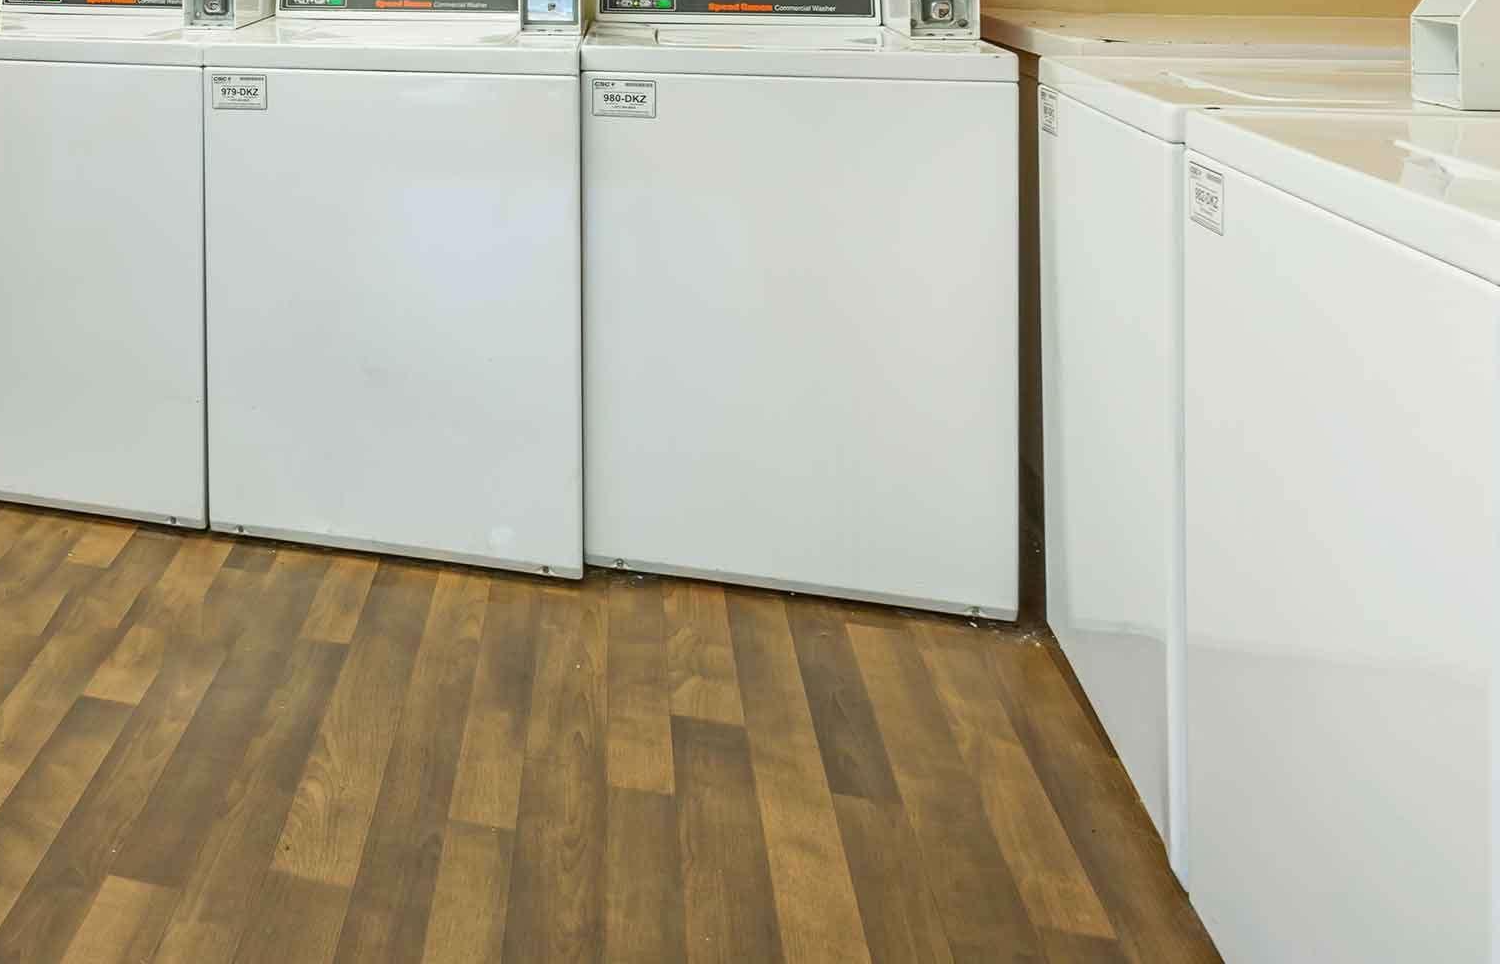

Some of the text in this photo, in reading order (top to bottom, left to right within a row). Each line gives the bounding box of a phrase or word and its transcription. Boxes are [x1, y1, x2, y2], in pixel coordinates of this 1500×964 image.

[774, 4, 811, 12] Commercial
[220, 87, 259, 96] 979-DKZ
[603, 93, 647, 103] 980-DKZ
